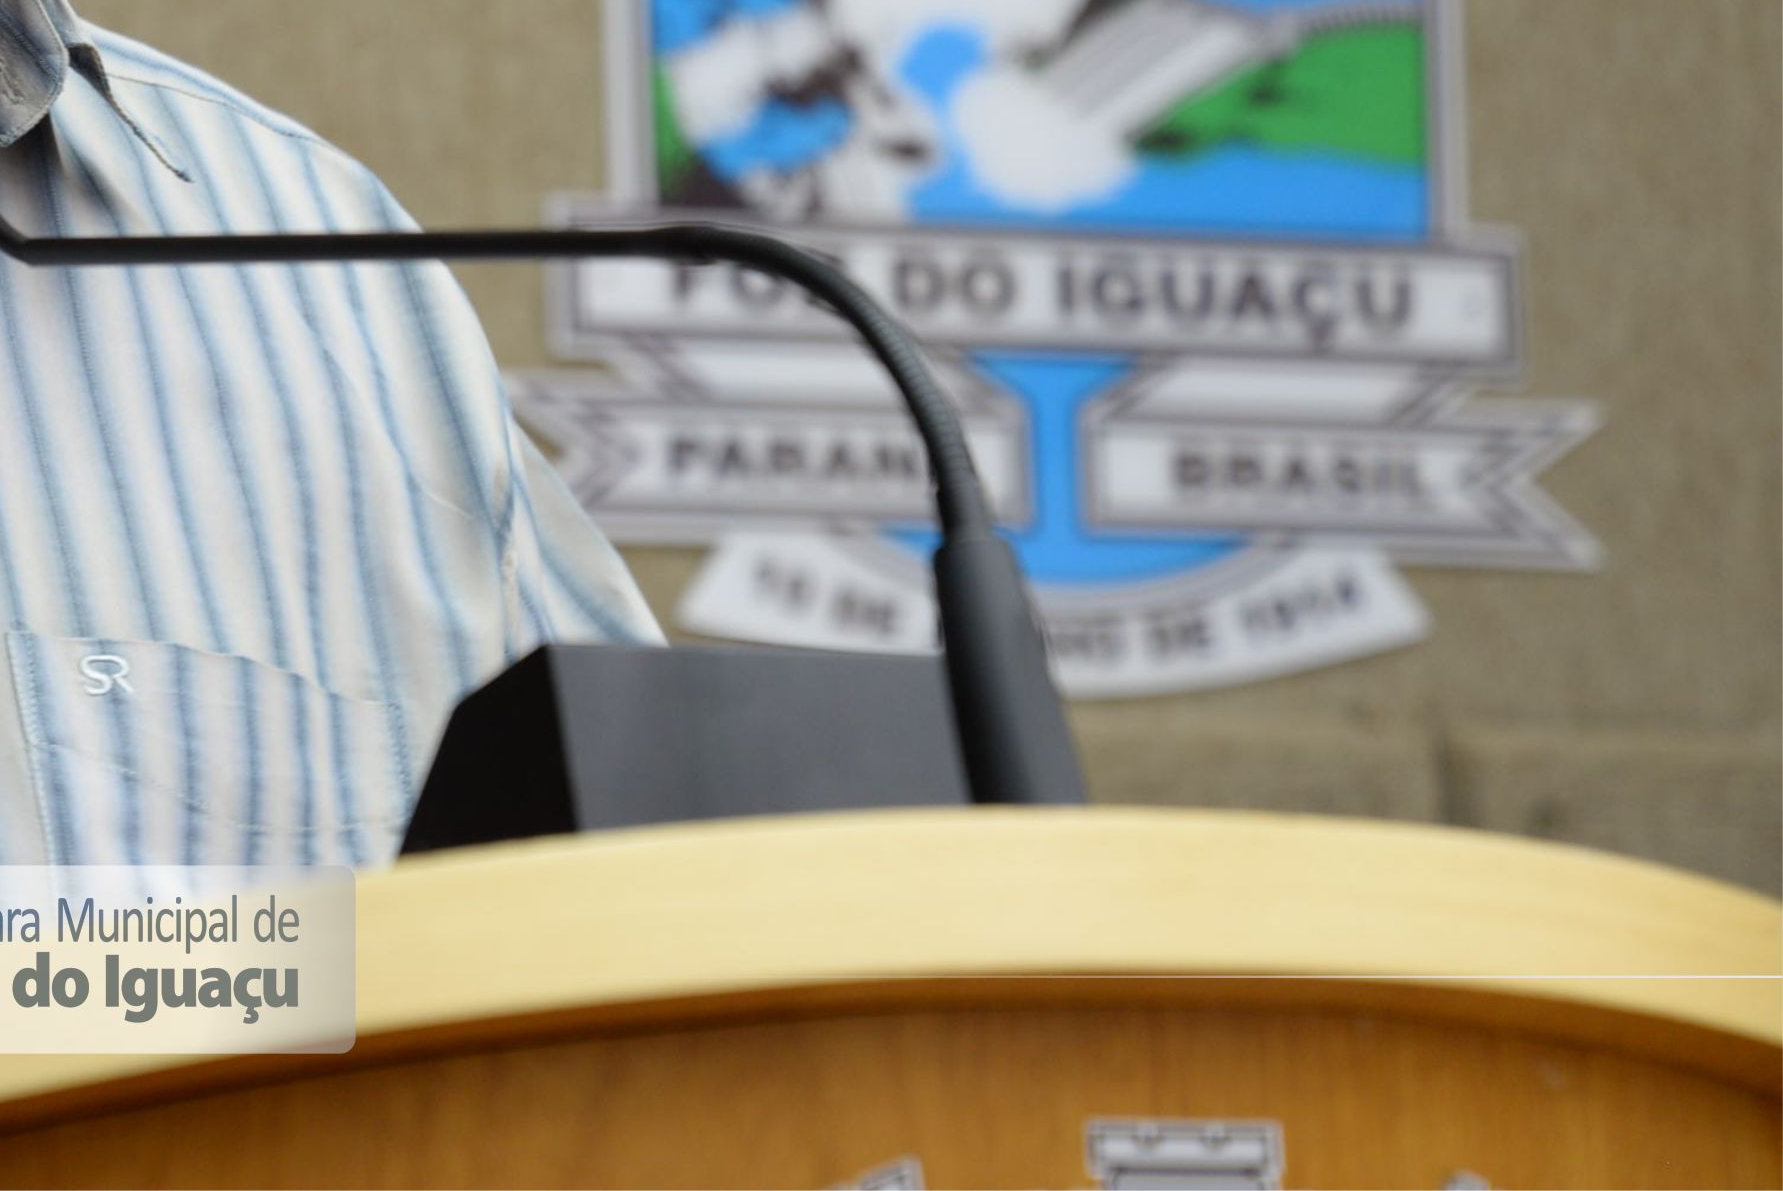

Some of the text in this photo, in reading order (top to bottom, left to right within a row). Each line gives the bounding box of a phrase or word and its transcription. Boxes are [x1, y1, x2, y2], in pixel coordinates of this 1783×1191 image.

[895, 252, 1017, 315] DO
[1056, 258, 1415, 350] IGUAÇU
[668, 435, 1429, 500] PARAN BRASIL
[79, 655, 134, 696] SR
